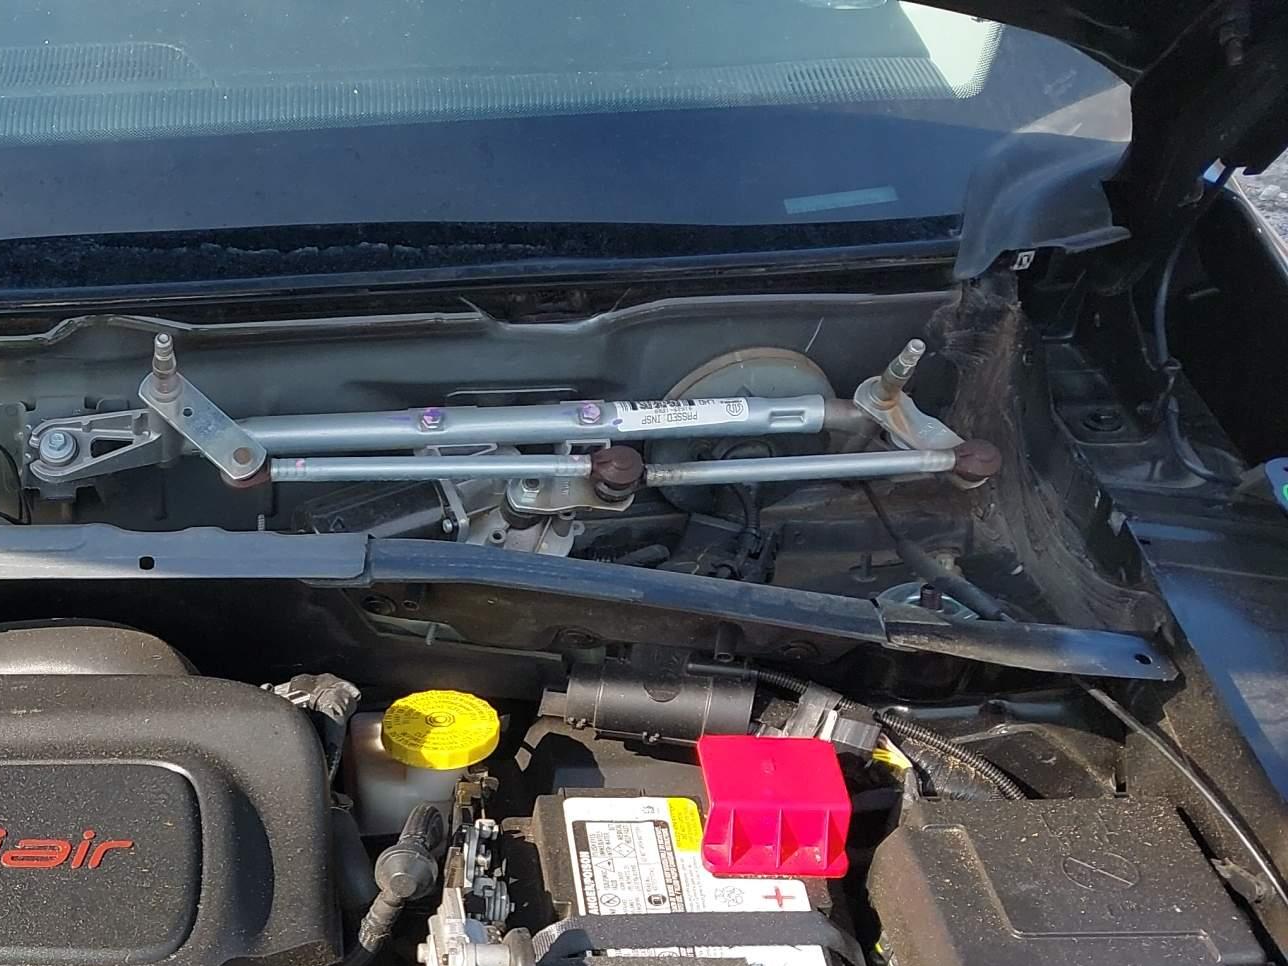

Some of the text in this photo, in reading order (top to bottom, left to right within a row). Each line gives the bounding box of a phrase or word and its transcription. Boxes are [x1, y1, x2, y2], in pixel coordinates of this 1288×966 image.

[641, 411, 699, 425] PASSED INSP
[578, 850, 600, 915] ANGER/POISON
